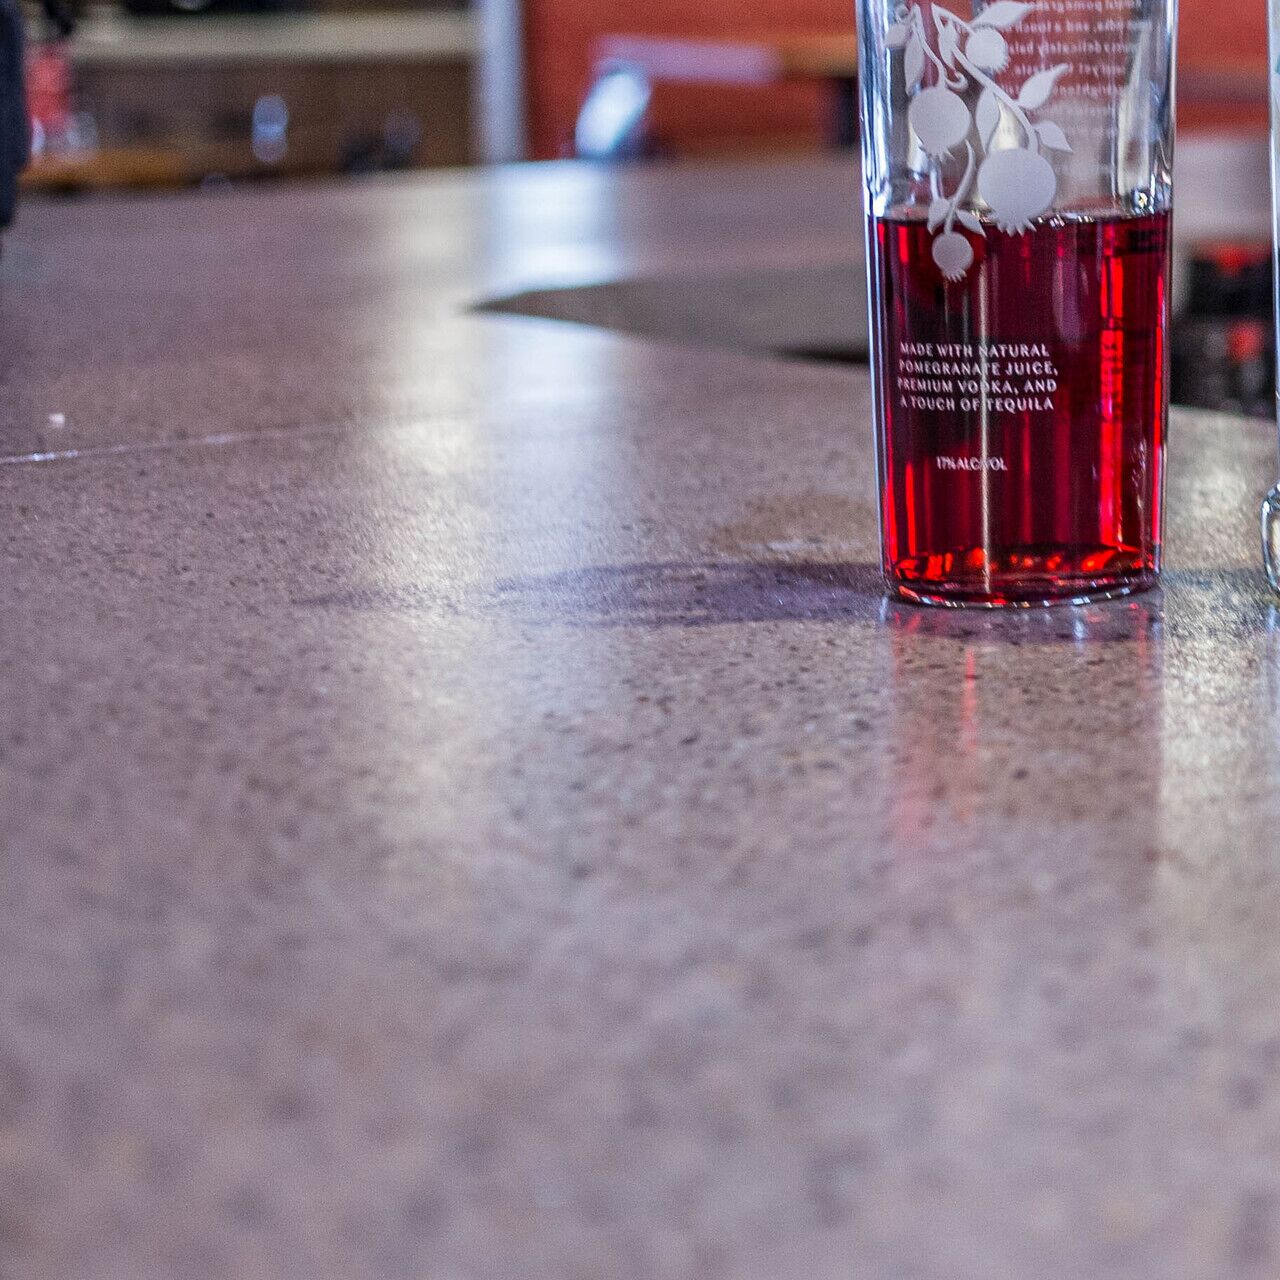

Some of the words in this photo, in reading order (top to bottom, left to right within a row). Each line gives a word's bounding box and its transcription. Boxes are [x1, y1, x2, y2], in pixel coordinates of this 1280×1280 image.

[900, 341, 934, 357] MADE
[936, 343, 973, 358] WITH
[978, 343, 1050, 358] NATURAL
[899, 358, 1001, 376] POMEGRANATE
[1005, 360, 1059, 377] JUICE,
[897, 376, 953, 394] PREMIUM
[956, 379, 1019, 395] VODKA,
[1023, 378, 1058, 393] AND
[900, 394, 908, 408] A
[909, 395, 956, 412] TOUCH
[960, 397, 980, 412] OF
[986, 396, 1055, 415] TEQUILA
